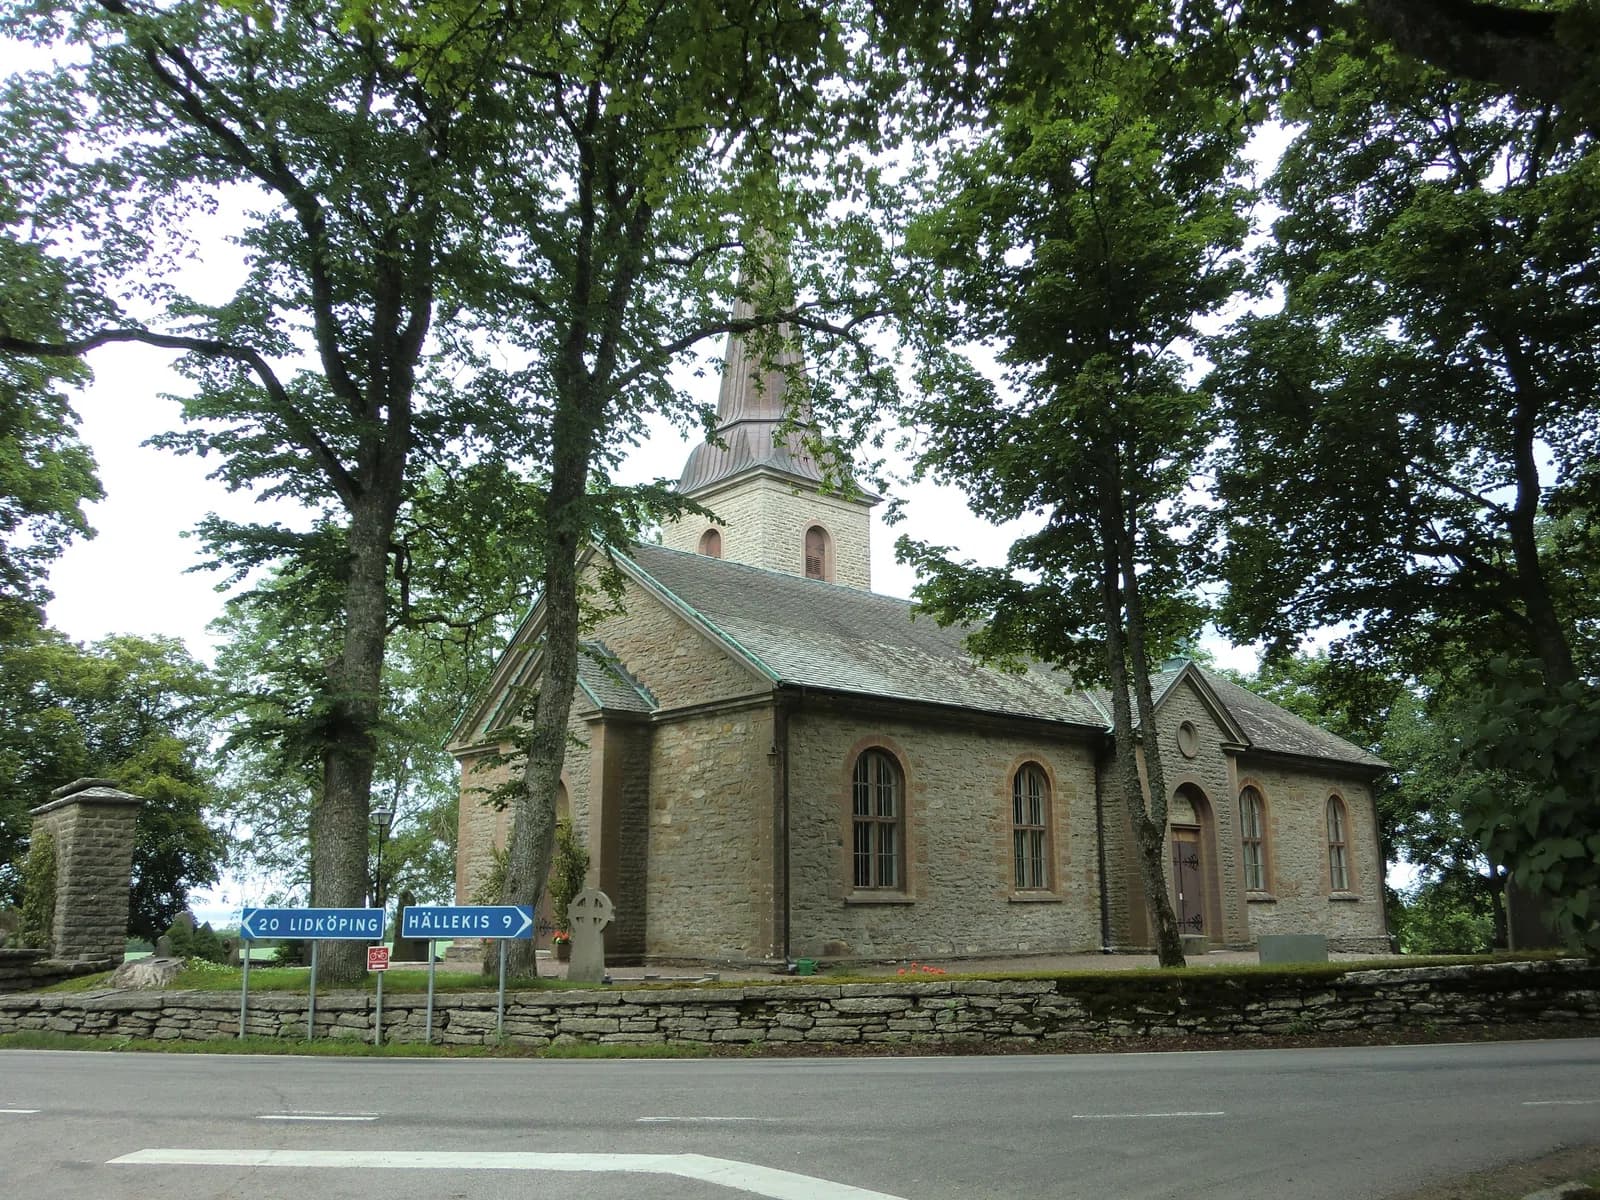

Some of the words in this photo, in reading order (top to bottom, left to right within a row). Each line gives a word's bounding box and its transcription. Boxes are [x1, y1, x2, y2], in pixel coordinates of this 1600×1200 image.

[258, 918, 280, 931] 20
[290, 915, 378, 931] LIDKÖPING
[409, 912, 490, 929] HÄLLEKIS
[502, 915, 512, 929] 9
